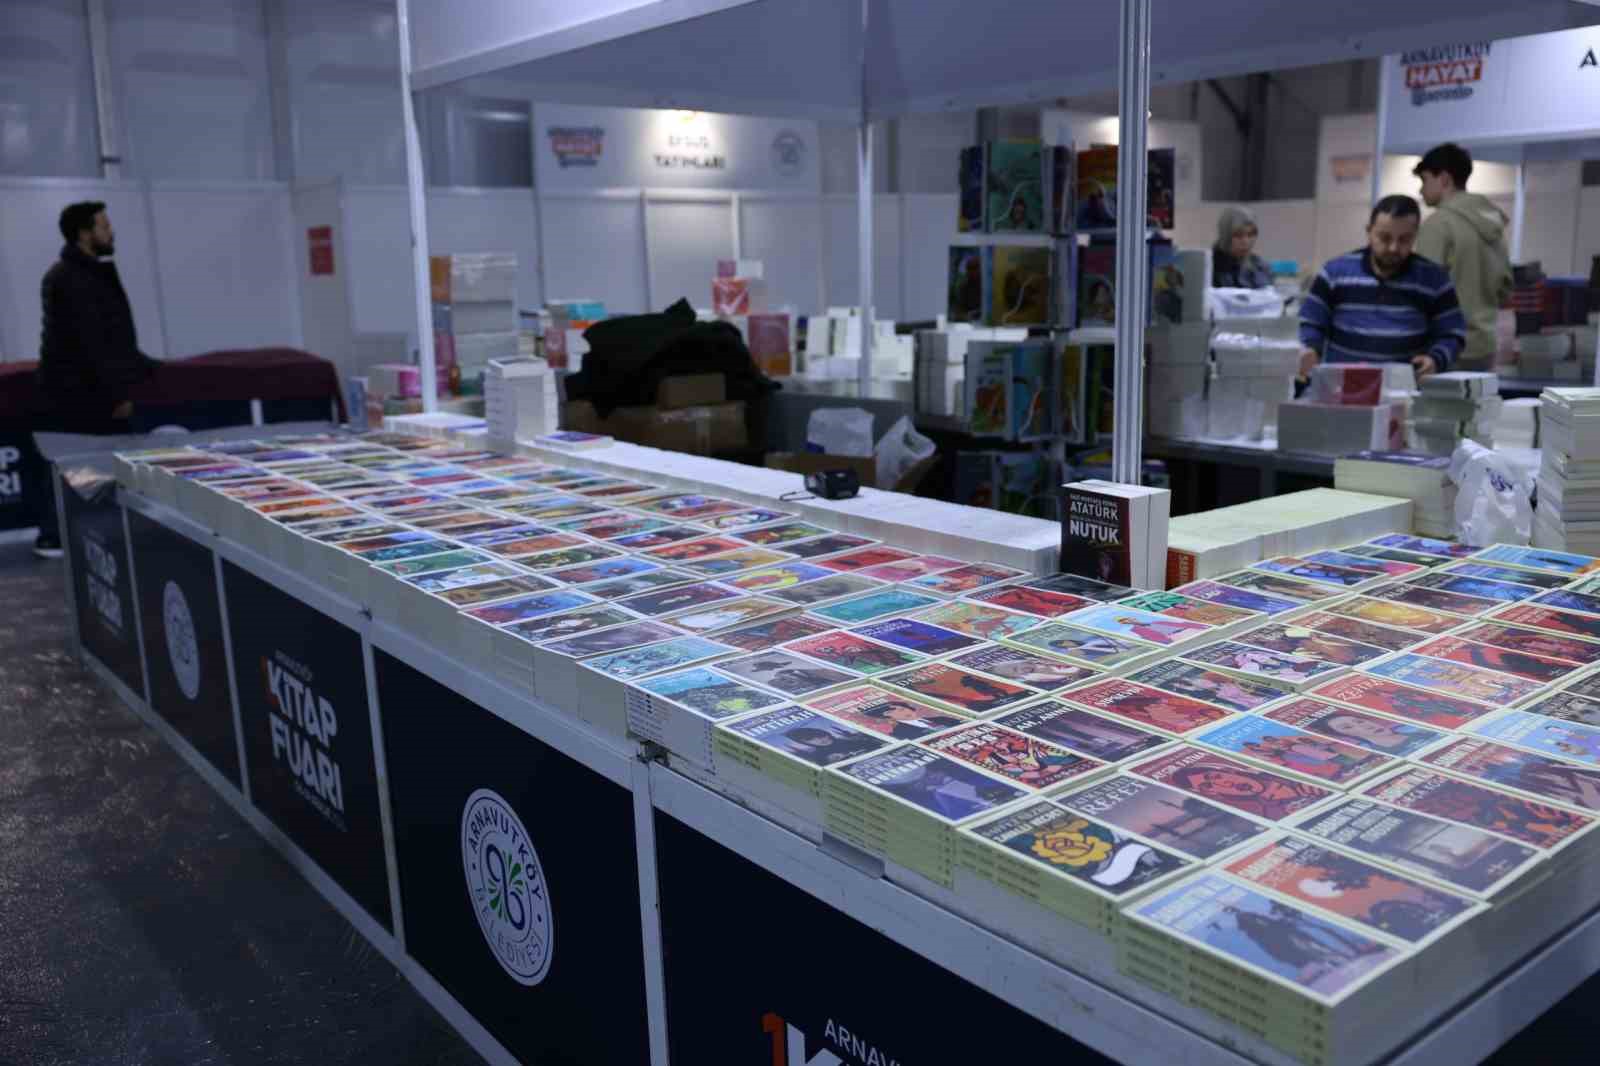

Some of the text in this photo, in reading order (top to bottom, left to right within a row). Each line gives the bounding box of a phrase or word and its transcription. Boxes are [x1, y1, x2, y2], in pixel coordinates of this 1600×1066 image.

[1409, 63, 1476, 85] HAYAT
[1070, 501, 1119, 521] ATATÜRK
[1070, 519, 1121, 545] NUTUK
[269, 711, 345, 816] FUARI
[1080, 780, 1147, 815] REFET
[467, 806, 544, 902] ARNAVUTKÖY
